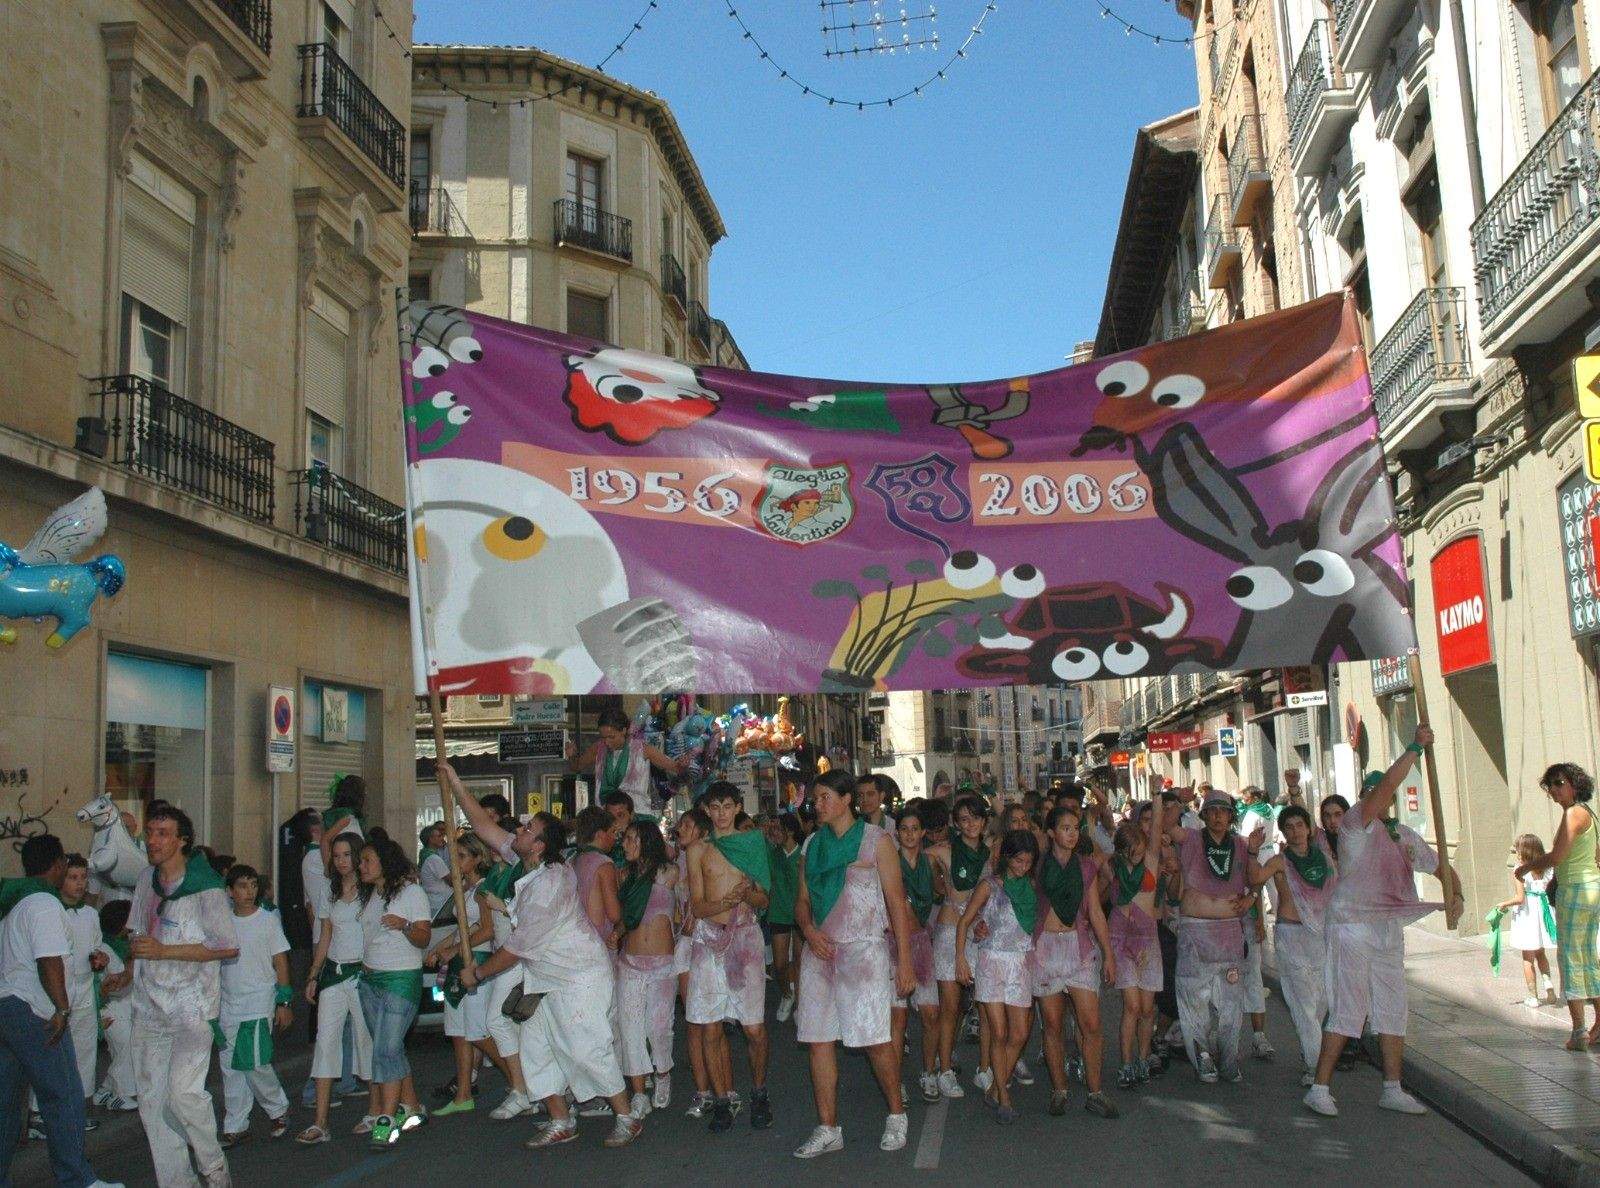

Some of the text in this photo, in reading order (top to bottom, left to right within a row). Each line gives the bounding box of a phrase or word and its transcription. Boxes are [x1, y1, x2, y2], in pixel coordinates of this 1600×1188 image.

[568, 465, 741, 517] 1956
[979, 472, 1147, 516] 2006
[1440, 595, 1484, 636] KAYMO
